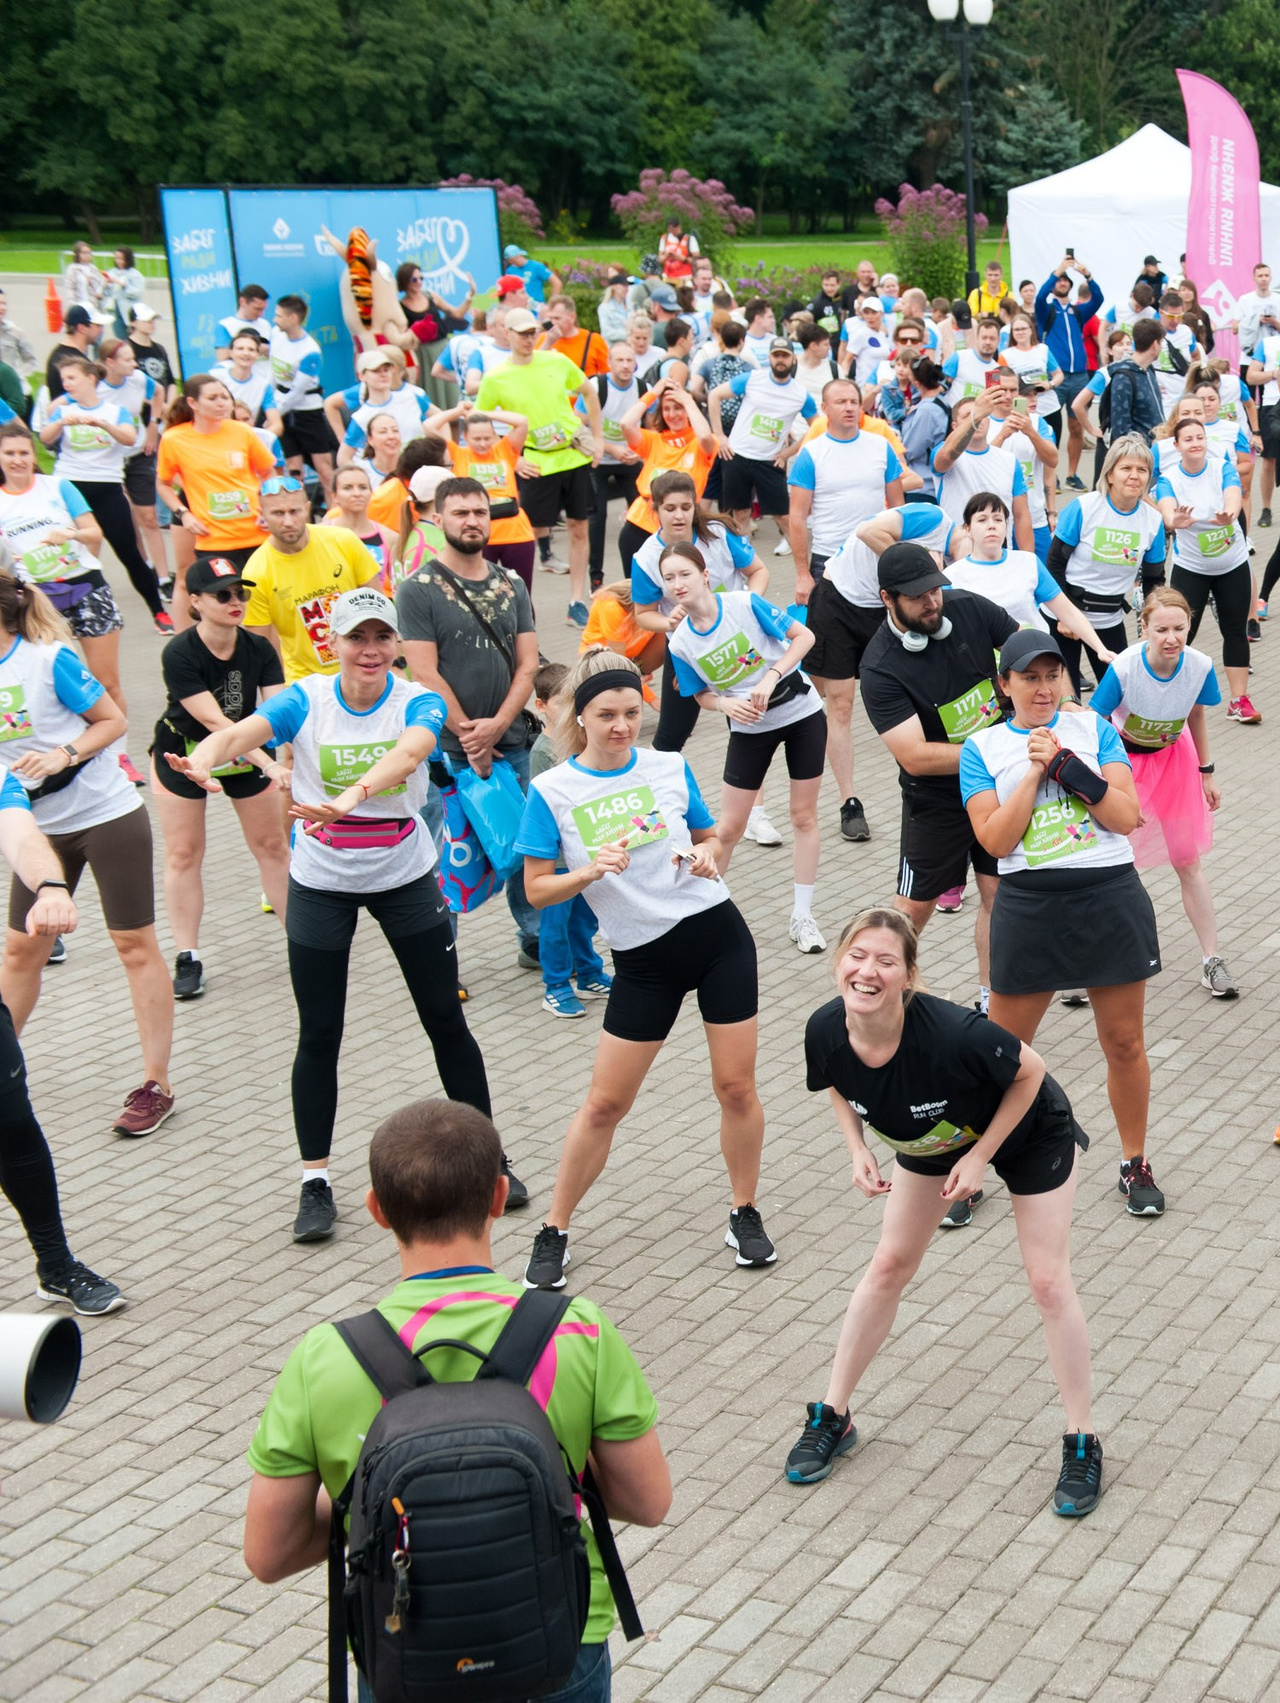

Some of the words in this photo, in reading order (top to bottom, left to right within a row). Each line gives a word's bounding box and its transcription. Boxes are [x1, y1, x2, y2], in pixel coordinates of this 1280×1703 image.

[213, 490, 241, 502] 1259
[1105, 530, 1132, 545] 1126
[1206, 529, 1228, 543] 1221
[294, 584, 340, 605] МАРАФОН
[349, 593, 380, 604] DENIM
[705, 640, 738, 668] 1577
[224, 670, 243, 719] didas
[953, 689, 984, 716] 1171
[1140, 719, 1174, 732] 1172
[331, 746, 388, 766] 1549
[584, 792, 644, 825] 1486
[1031, 802, 1076, 830] 1256
[910, 1100, 948, 1113] BetBoom
[913, 1111, 926, 1120] RUN
[928, 1108, 945, 1117] CLUB
